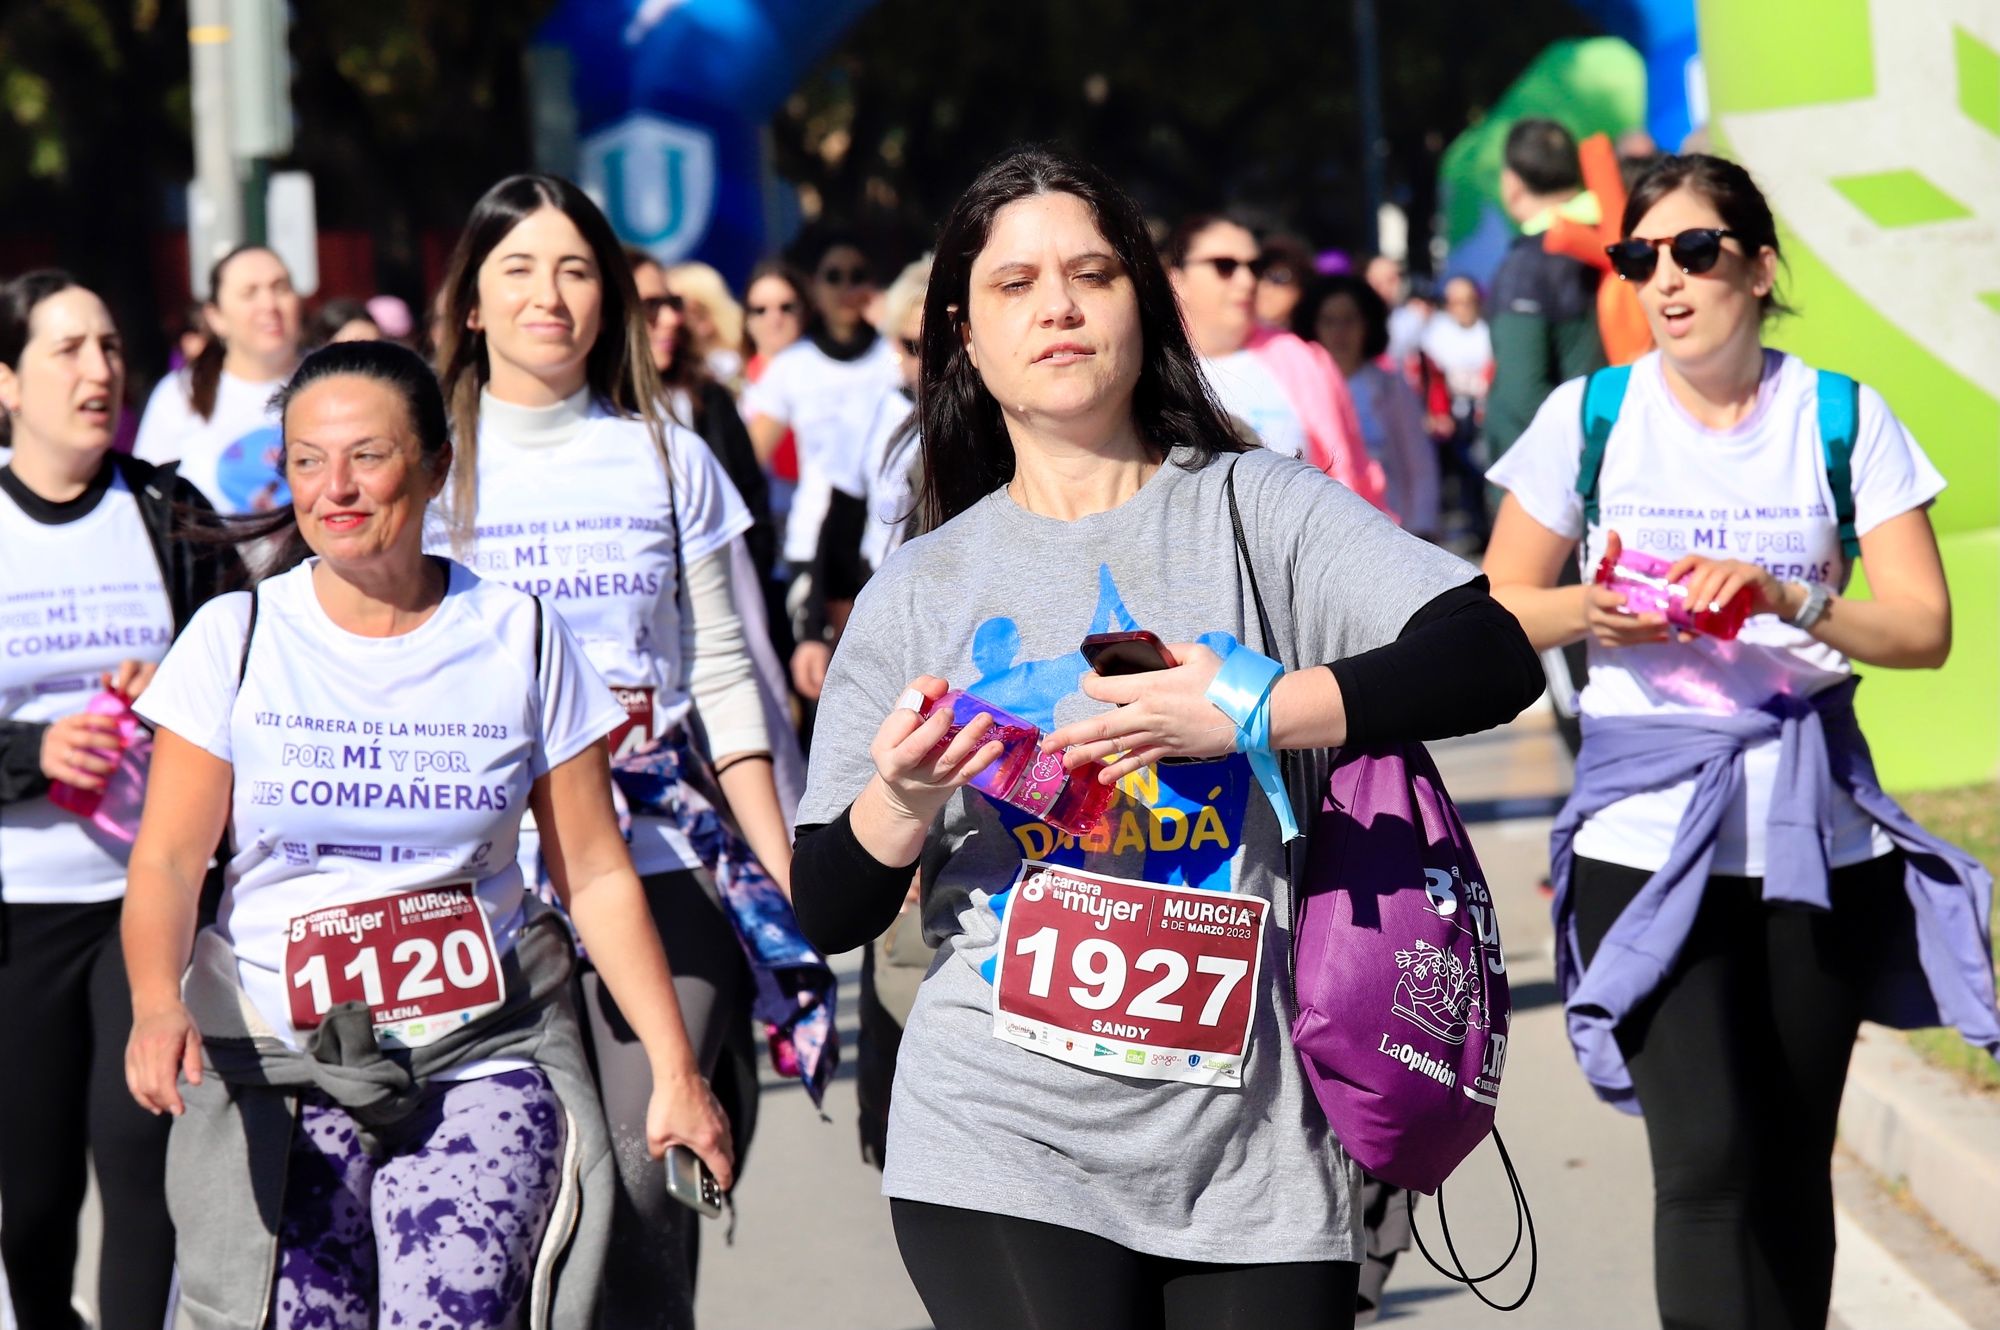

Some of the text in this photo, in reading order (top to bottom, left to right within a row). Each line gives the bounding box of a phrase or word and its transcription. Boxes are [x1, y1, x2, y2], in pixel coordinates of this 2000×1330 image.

[604, 146, 684, 244] U
[474, 523, 524, 538] RRERA
[530, 521, 548, 535] DE
[553, 520, 571, 533] LA
[576, 517, 622, 531] MUJER
[1639, 506, 1704, 519] CARRERA
[1710, 509, 1728, 521] DE
[1733, 508, 1751, 521] LA
[1756, 507, 1800, 519] MUJER
[515, 537, 548, 567] MÍ
[554, 547, 573, 566] Y
[577, 541, 625, 564] POR
[1636, 523, 1806, 553] POR MÍ Y POR
[499, 568, 658, 600] MPAÑERAS
[7, 621, 169, 657] COMPAÑERA
[255, 711, 508, 740] VIII CARRERA DE LA MUJER 2023
[282, 738, 470, 773] POR MÍ Y POR
[290, 777, 508, 811] COMPAÑERAS
[1013, 786, 1230, 861] DBADÁ
[1052, 875, 1102, 896] carrera
[398, 889, 469, 916] MURCIA
[1062, 890, 1144, 931] mujer
[1163, 898, 1252, 927] MURCIA
[319, 910, 385, 944] mujer
[1160, 919, 1251, 939] 5 DE MARZO 2023
[293, 929, 490, 1015] 1120
[1015, 926, 1249, 1027] 1927
[1091, 1019, 1151, 1041] SANDY
[1377, 1033, 1457, 1089] LaOpinión
